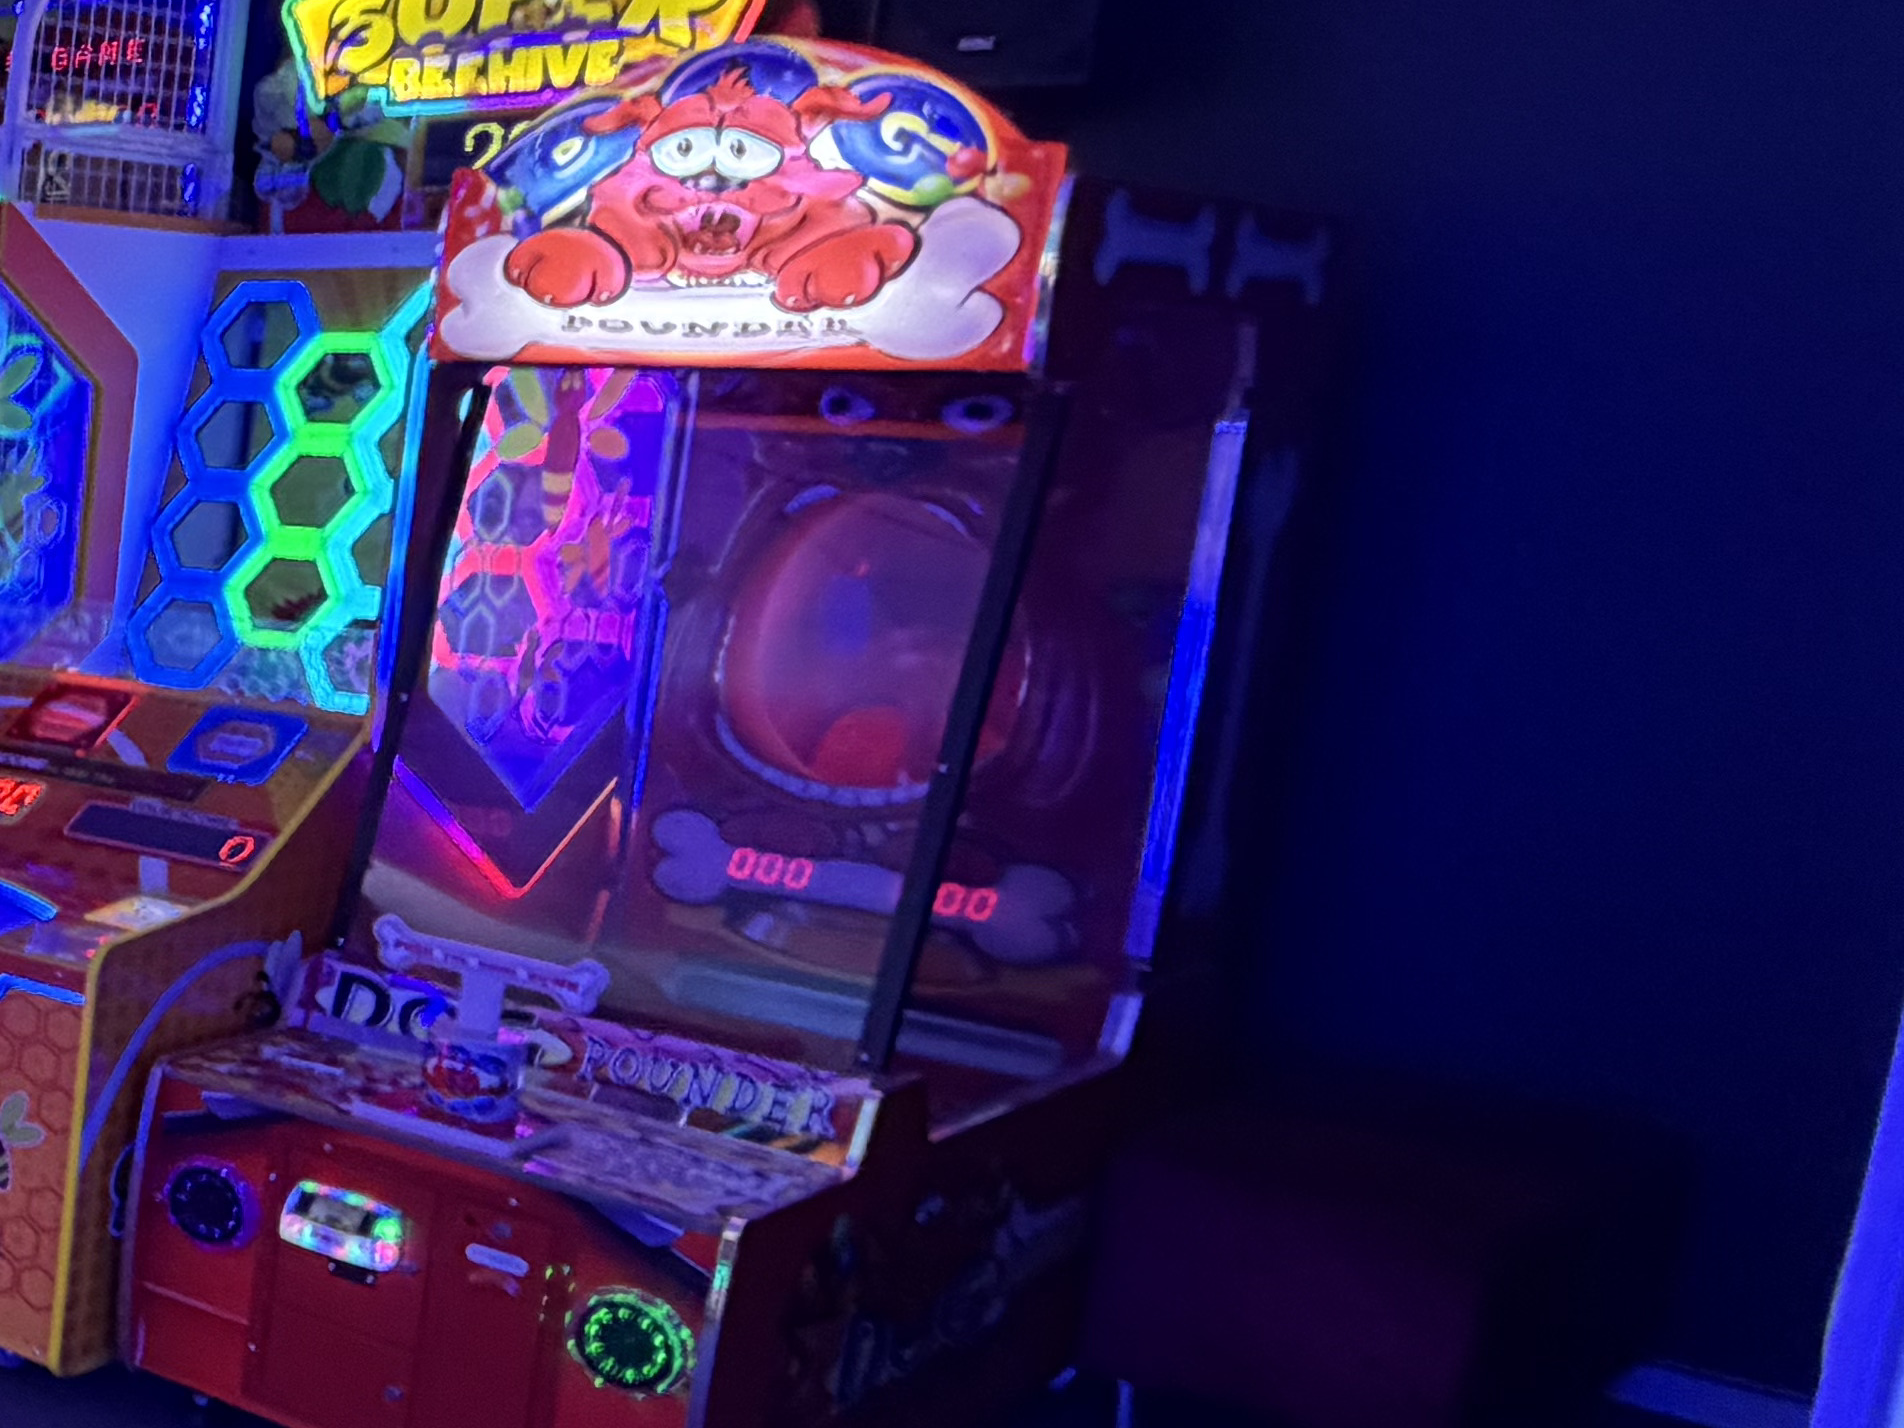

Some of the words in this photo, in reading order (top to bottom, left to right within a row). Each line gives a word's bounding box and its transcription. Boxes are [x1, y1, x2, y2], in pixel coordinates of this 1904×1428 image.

[51, 38, 145, 70] GAME
[389, 39, 622, 102] BEEHIVE
[561, 314, 864, 339] POUNDER
[219, 835, 255, 868] 0
[727, 847, 814, 890] 000
[574, 1034, 838, 1140] POUNDER
